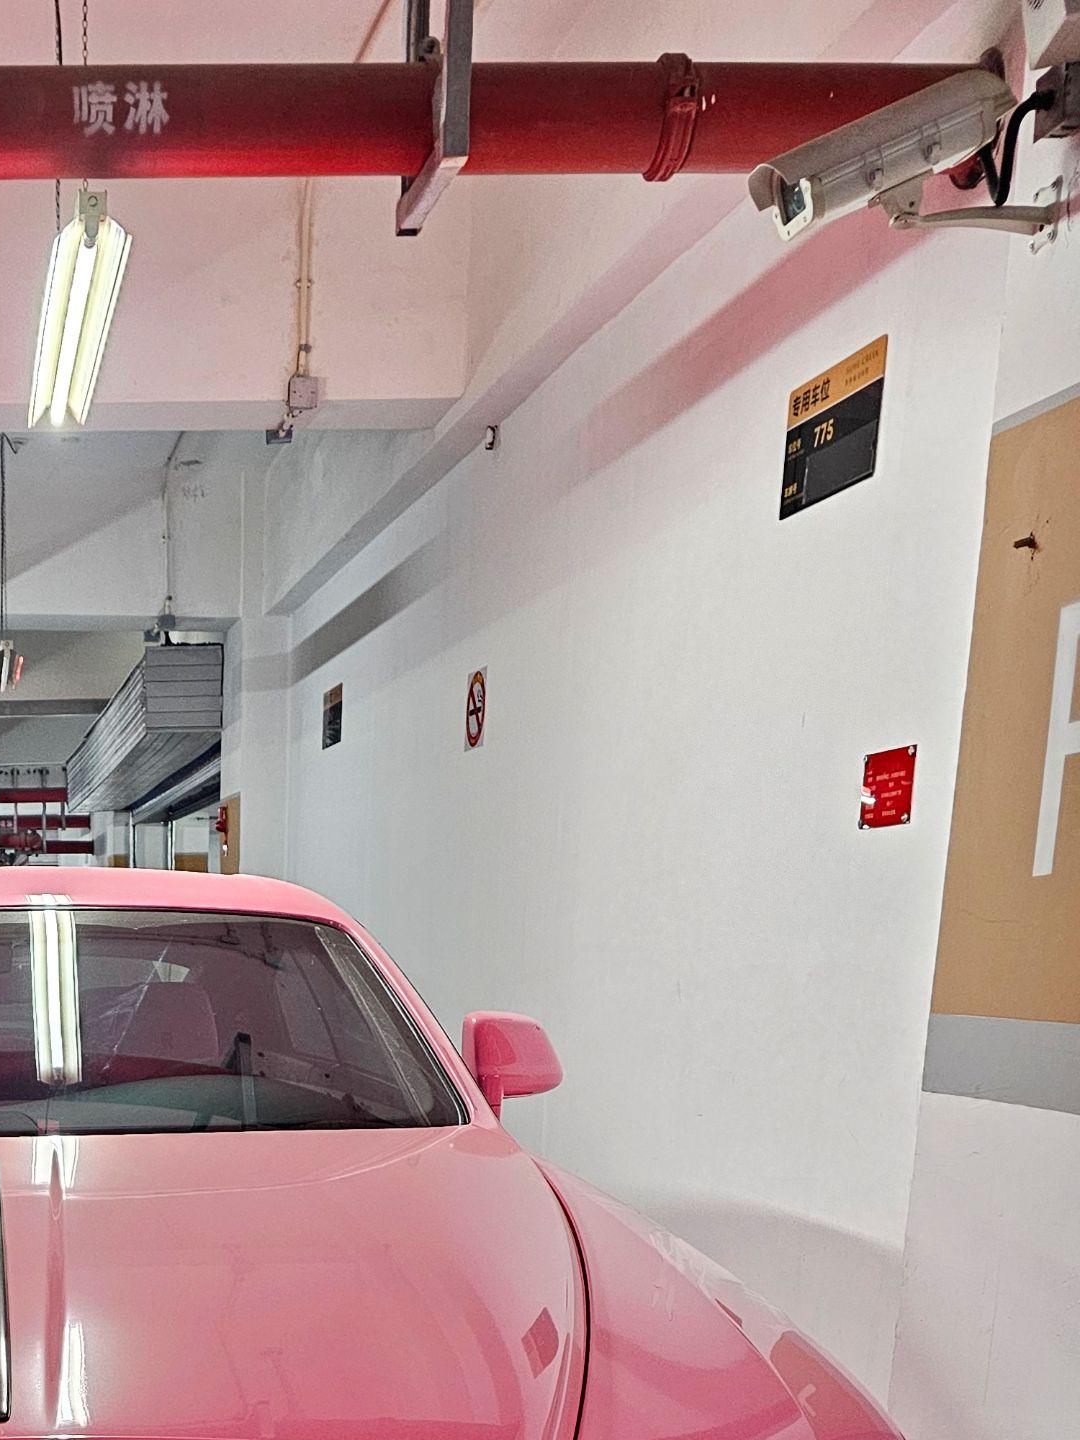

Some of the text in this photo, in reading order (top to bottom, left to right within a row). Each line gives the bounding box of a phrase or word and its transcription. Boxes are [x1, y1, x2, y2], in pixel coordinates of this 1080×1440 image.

[72, 80, 170, 137] 喷淋
[792, 376, 831, 417] 专用车位
[813, 418, 834, 448] 775
